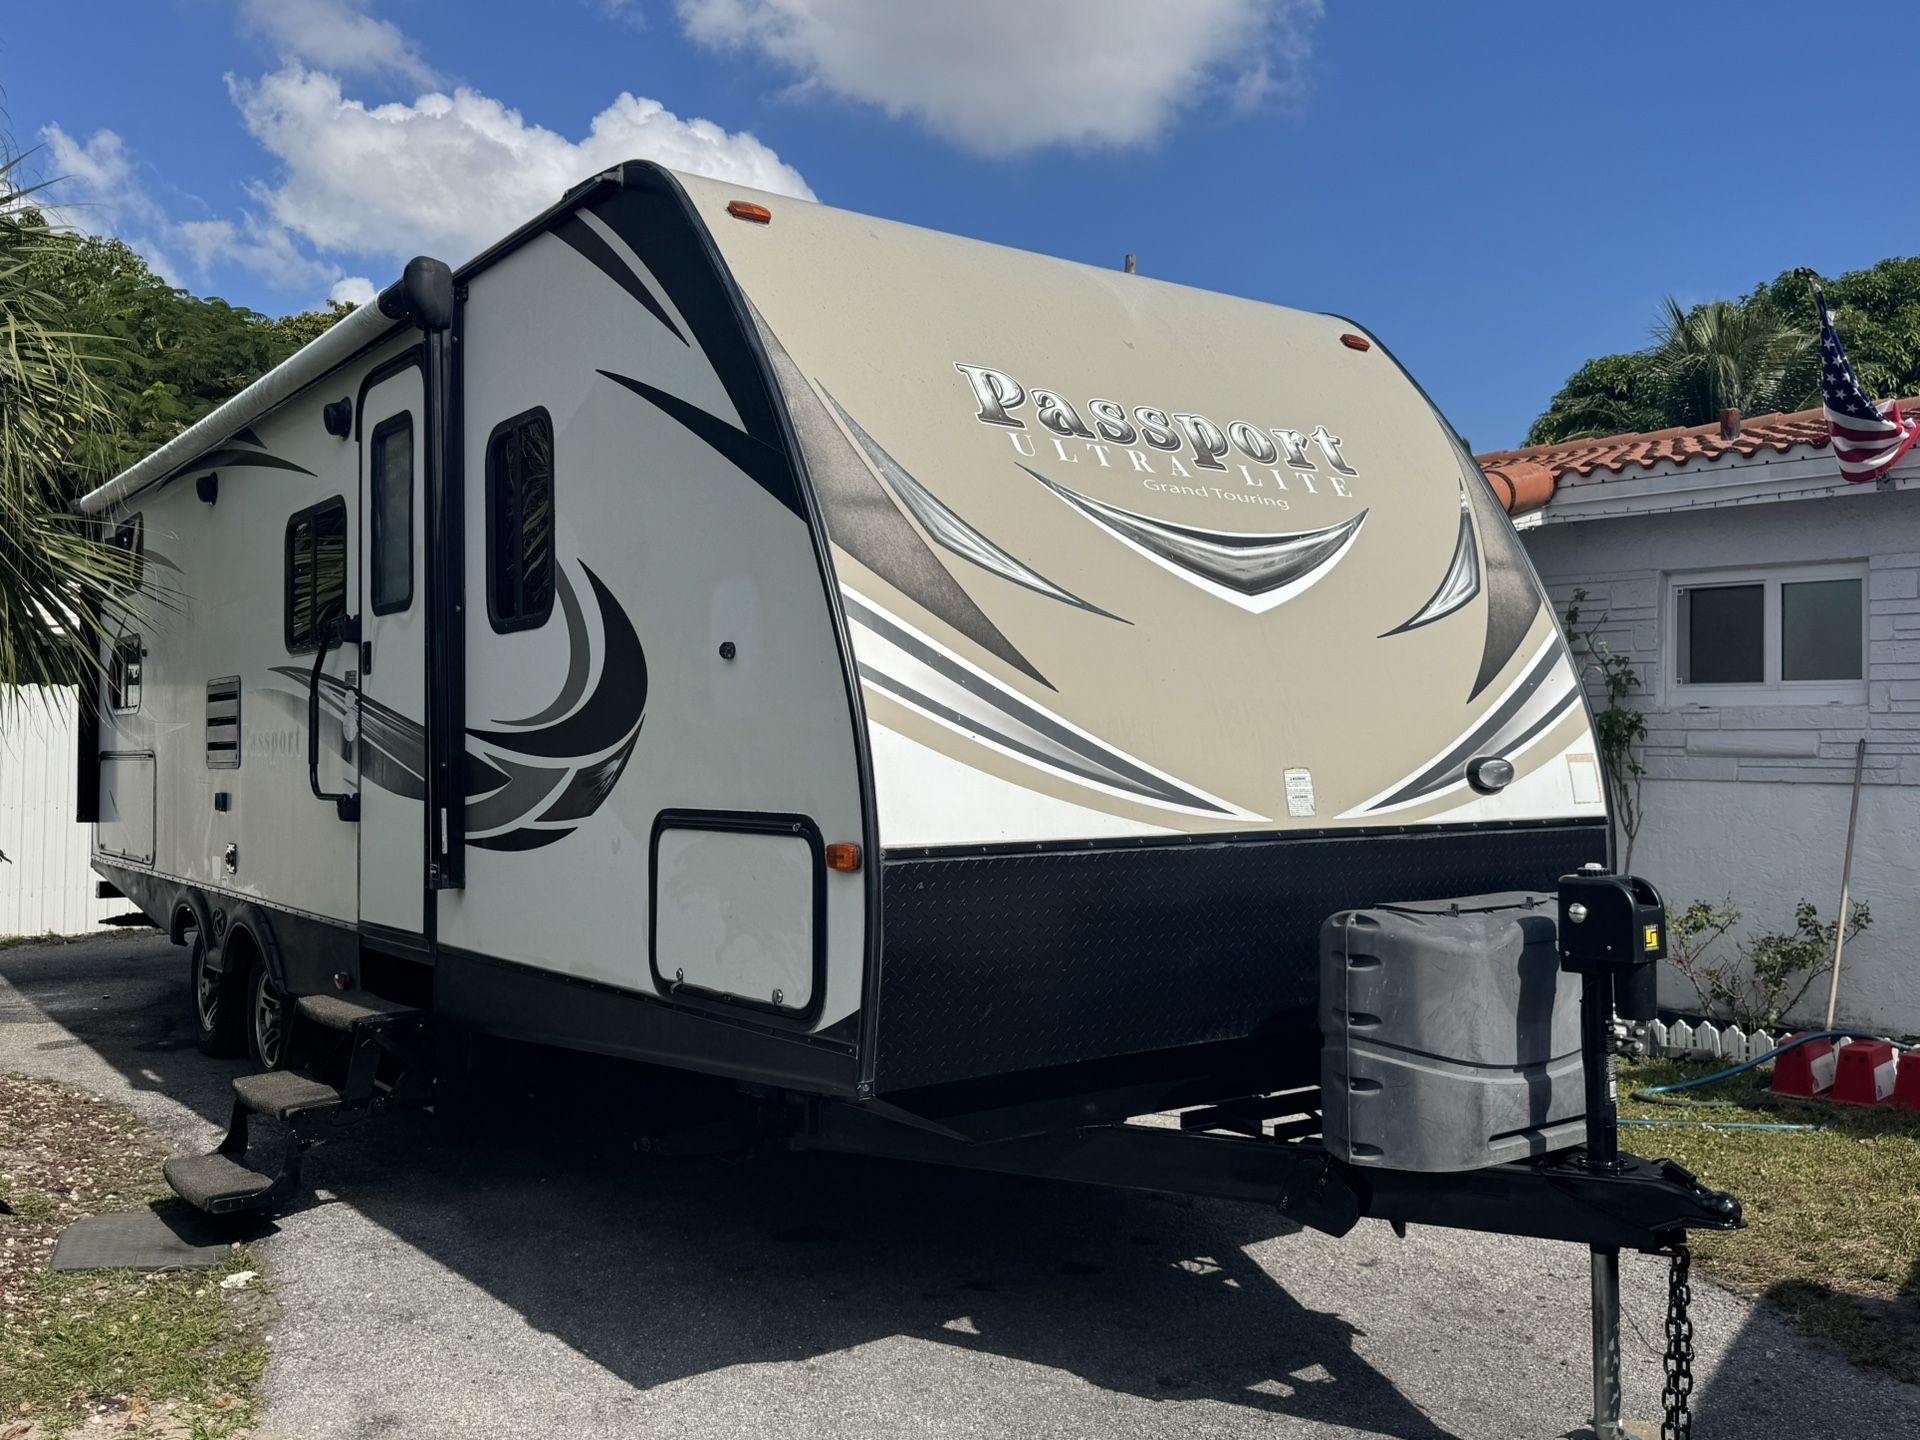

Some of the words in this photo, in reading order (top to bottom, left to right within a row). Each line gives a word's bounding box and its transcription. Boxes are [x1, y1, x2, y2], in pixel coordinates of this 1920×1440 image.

[953, 362, 1359, 476] Passport
[1006, 431, 1192, 478] ULTRA
[1237, 464, 1353, 498] LITE
[1143, 478, 1208, 500] Grand
[1209, 487, 1290, 510] Touring
